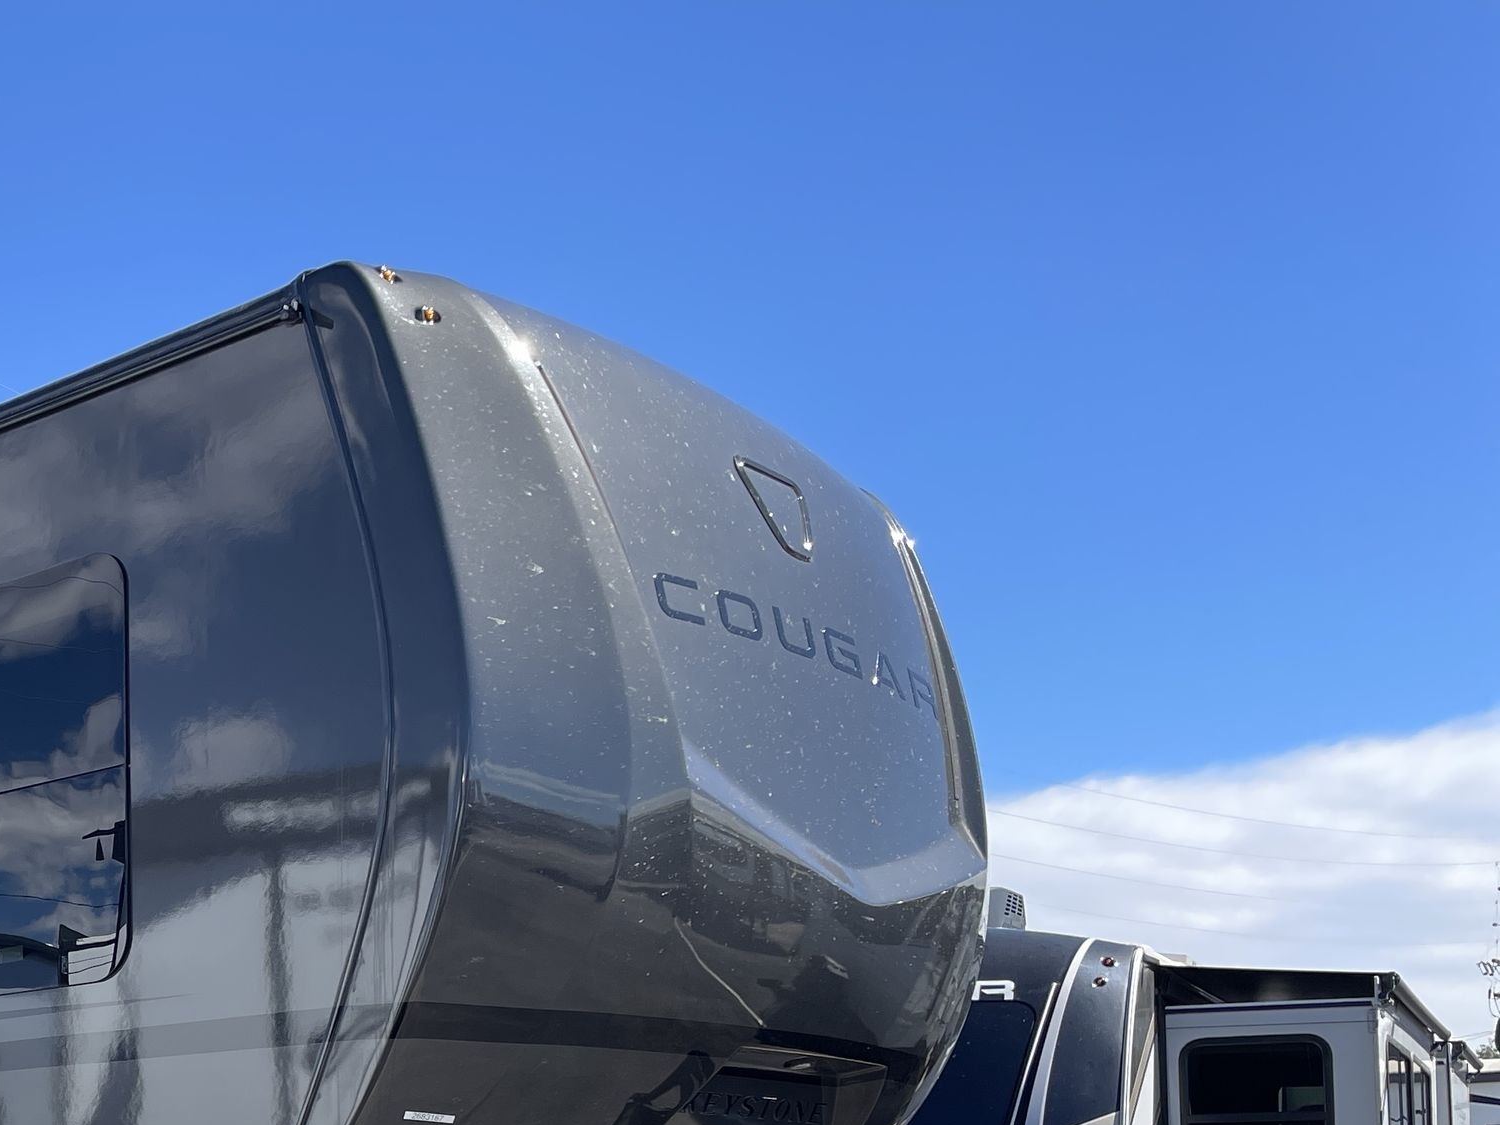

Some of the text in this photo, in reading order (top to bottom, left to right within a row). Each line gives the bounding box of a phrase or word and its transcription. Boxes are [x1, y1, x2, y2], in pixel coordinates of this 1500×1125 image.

[652, 572, 939, 721] COUGAR
[971, 979, 1015, 1002] R
[678, 1090, 828, 1125] KEYSTONE
